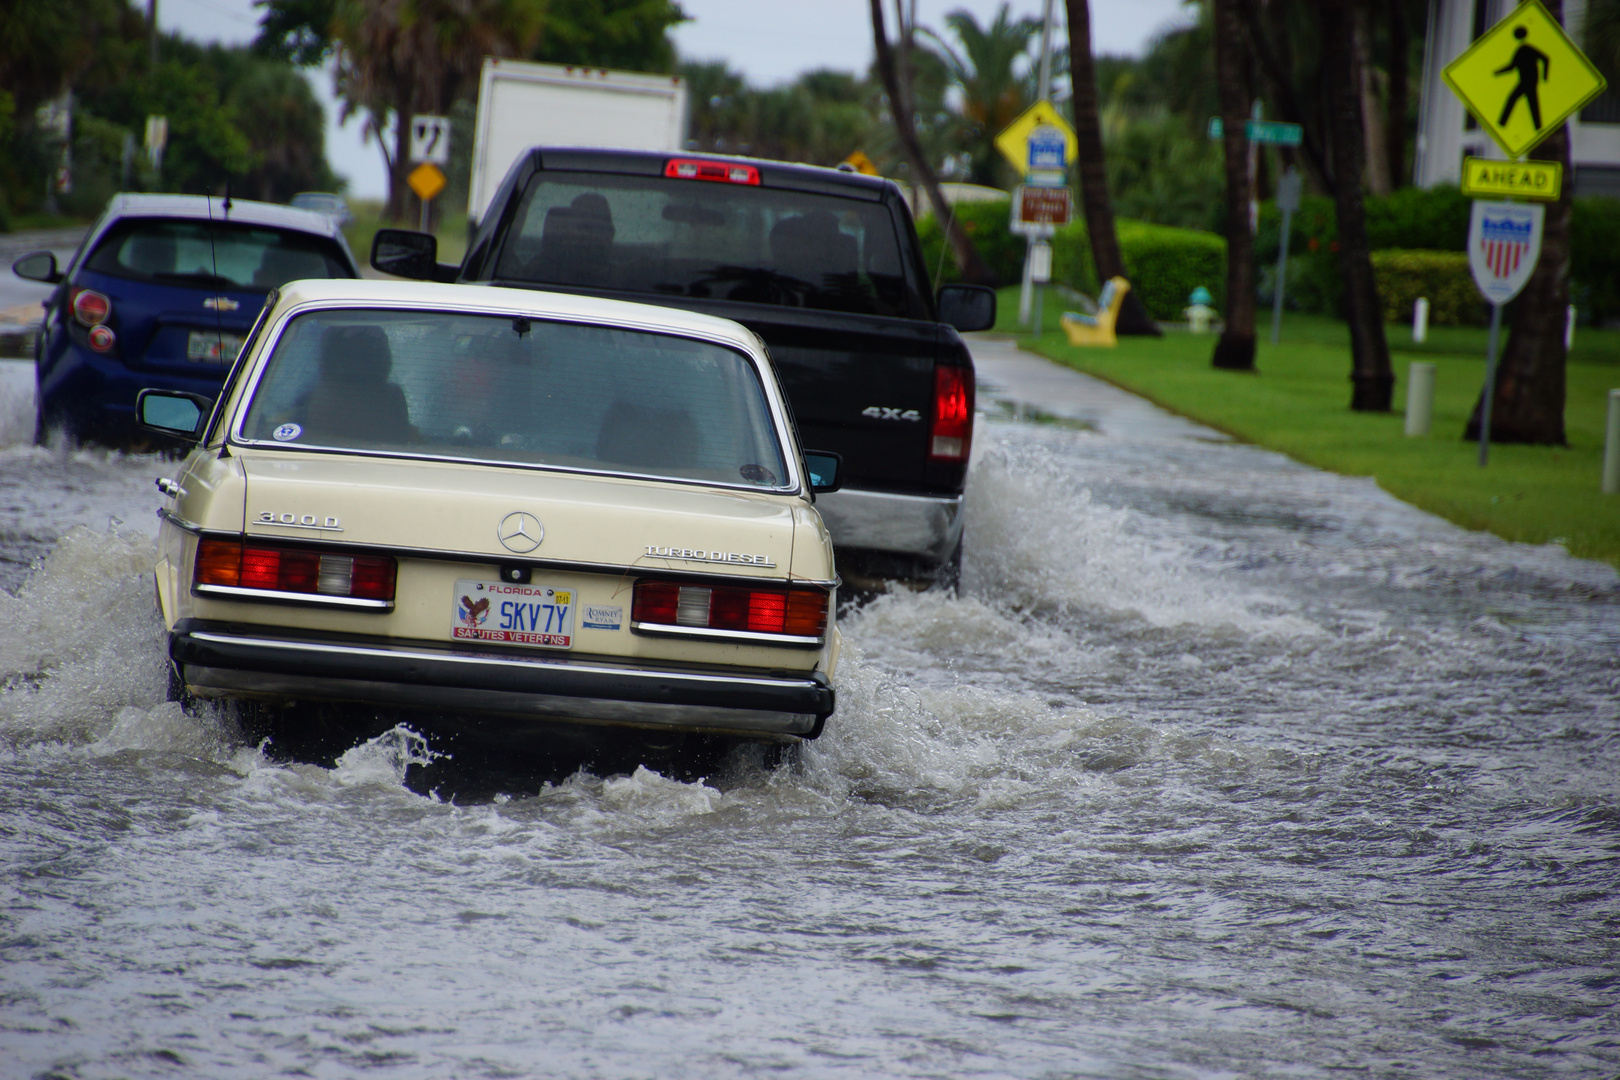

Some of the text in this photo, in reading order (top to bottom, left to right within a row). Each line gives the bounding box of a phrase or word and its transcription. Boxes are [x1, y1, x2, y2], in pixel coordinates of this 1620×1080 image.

[1477, 167, 1548, 190] AHEAD
[645, 545, 776, 565] TURBO DIESEL
[488, 585, 542, 597] FLORIDA
[500, 601, 568, 633] SKV7Y
[587, 607, 619, 619] ROMNEY
[595, 616, 614, 624] RYAN
